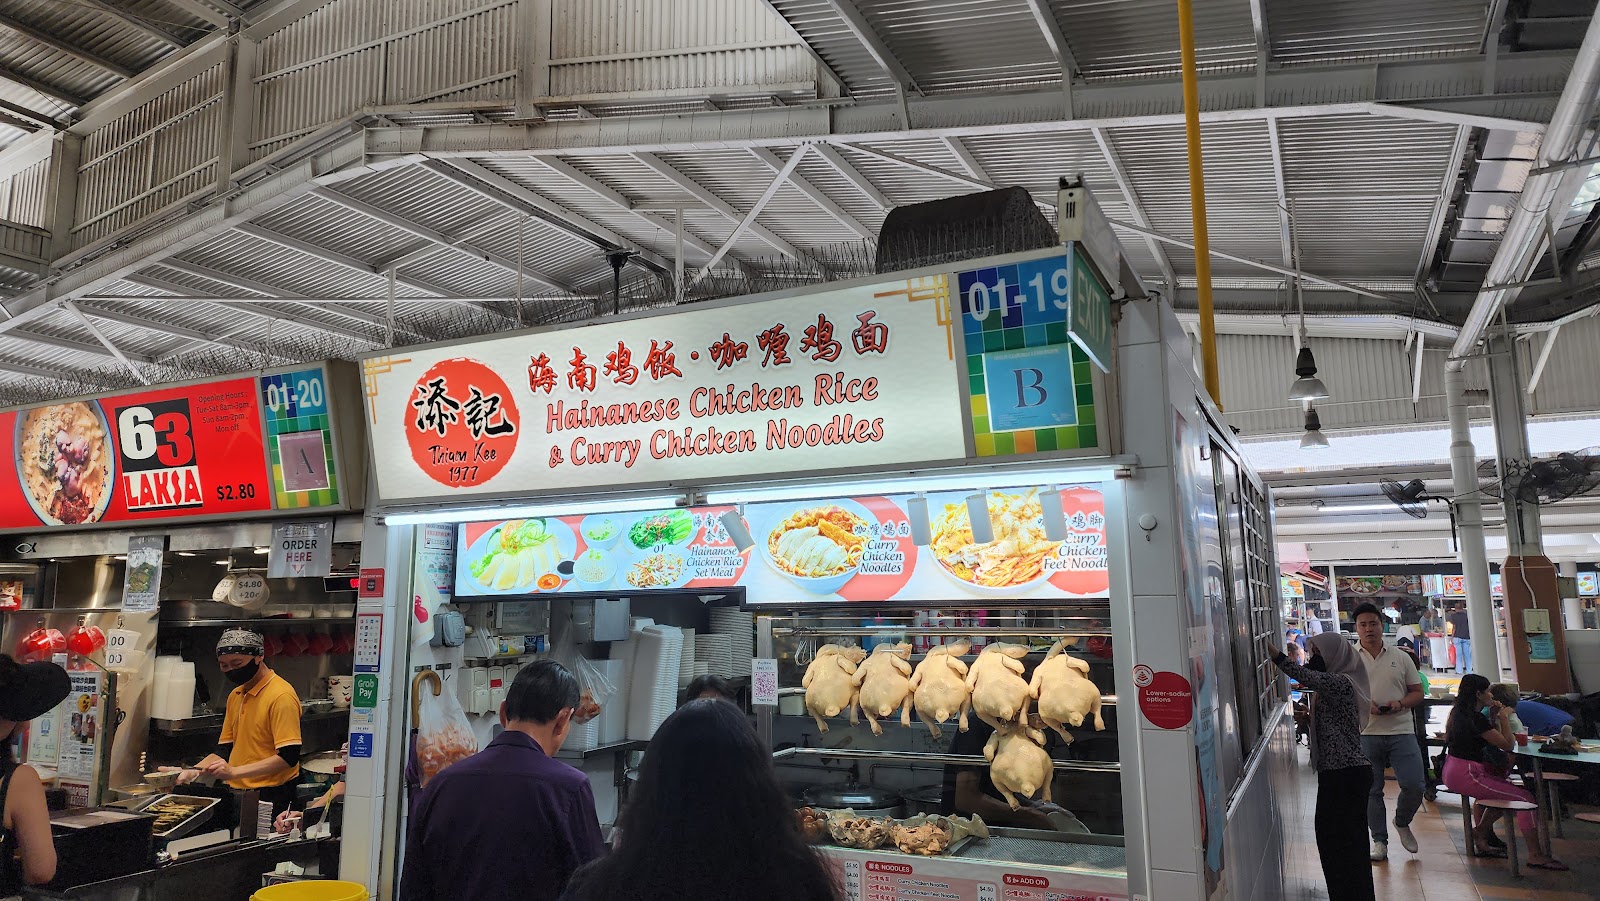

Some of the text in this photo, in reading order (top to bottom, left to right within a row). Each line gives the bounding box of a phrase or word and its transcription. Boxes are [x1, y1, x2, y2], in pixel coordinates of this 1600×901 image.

[969, 268, 1068, 321] 01-19
[1077, 268, 1101, 342] EXIT
[1012, 368, 1048, 409] B
[198, 394, 225, 405] Opening
[225, 391, 245, 401] Hours
[267, 378, 323, 412] 01-20
[196, 405, 219, 414] Tue-Sat
[220, 402, 249, 411] 8am-3pm
[414, 378, 514, 437] 添記
[546, 371, 879, 434] Hainanese Chicken Rice
[202, 416, 215, 424] Sun
[215, 413, 245, 422] 8am-2pm
[215, 423, 240, 433] Mon off
[118, 406, 194, 467] 63
[548, 413, 884, 468] & Curry Chicken Noodles
[428, 442, 497, 464] Thiam Kee
[296, 447, 315, 475] A
[449, 466, 478, 481] 1977
[122, 468, 202, 507] LAKSA
[217, 483, 256, 502] $2.80
[1065, 532, 1100, 545] Curry
[282, 540, 318, 550] ORDER
[653, 543, 667, 553] or
[867, 540, 897, 551] Curry
[1059, 545, 1107, 556] Chicken
[690, 546, 738, 556] Hainanese
[862, 551, 902, 561] Chicken
[286, 552, 312, 562] HERE
[686, 556, 742, 567] Chicken Rice
[860, 563, 902, 573] Noodles
[1044, 558, 1108, 569] Feet Noodl
[695, 567, 734, 577] Set Meal
[238, 580, 262, 589] $4.80
[357, 679, 375, 688] Grab
[359, 688, 373, 699] Pay
[1146, 690, 1191, 698] Lower-sodium
[1146, 696, 1171, 704] options
[881, 864, 910, 873] NOODLES
